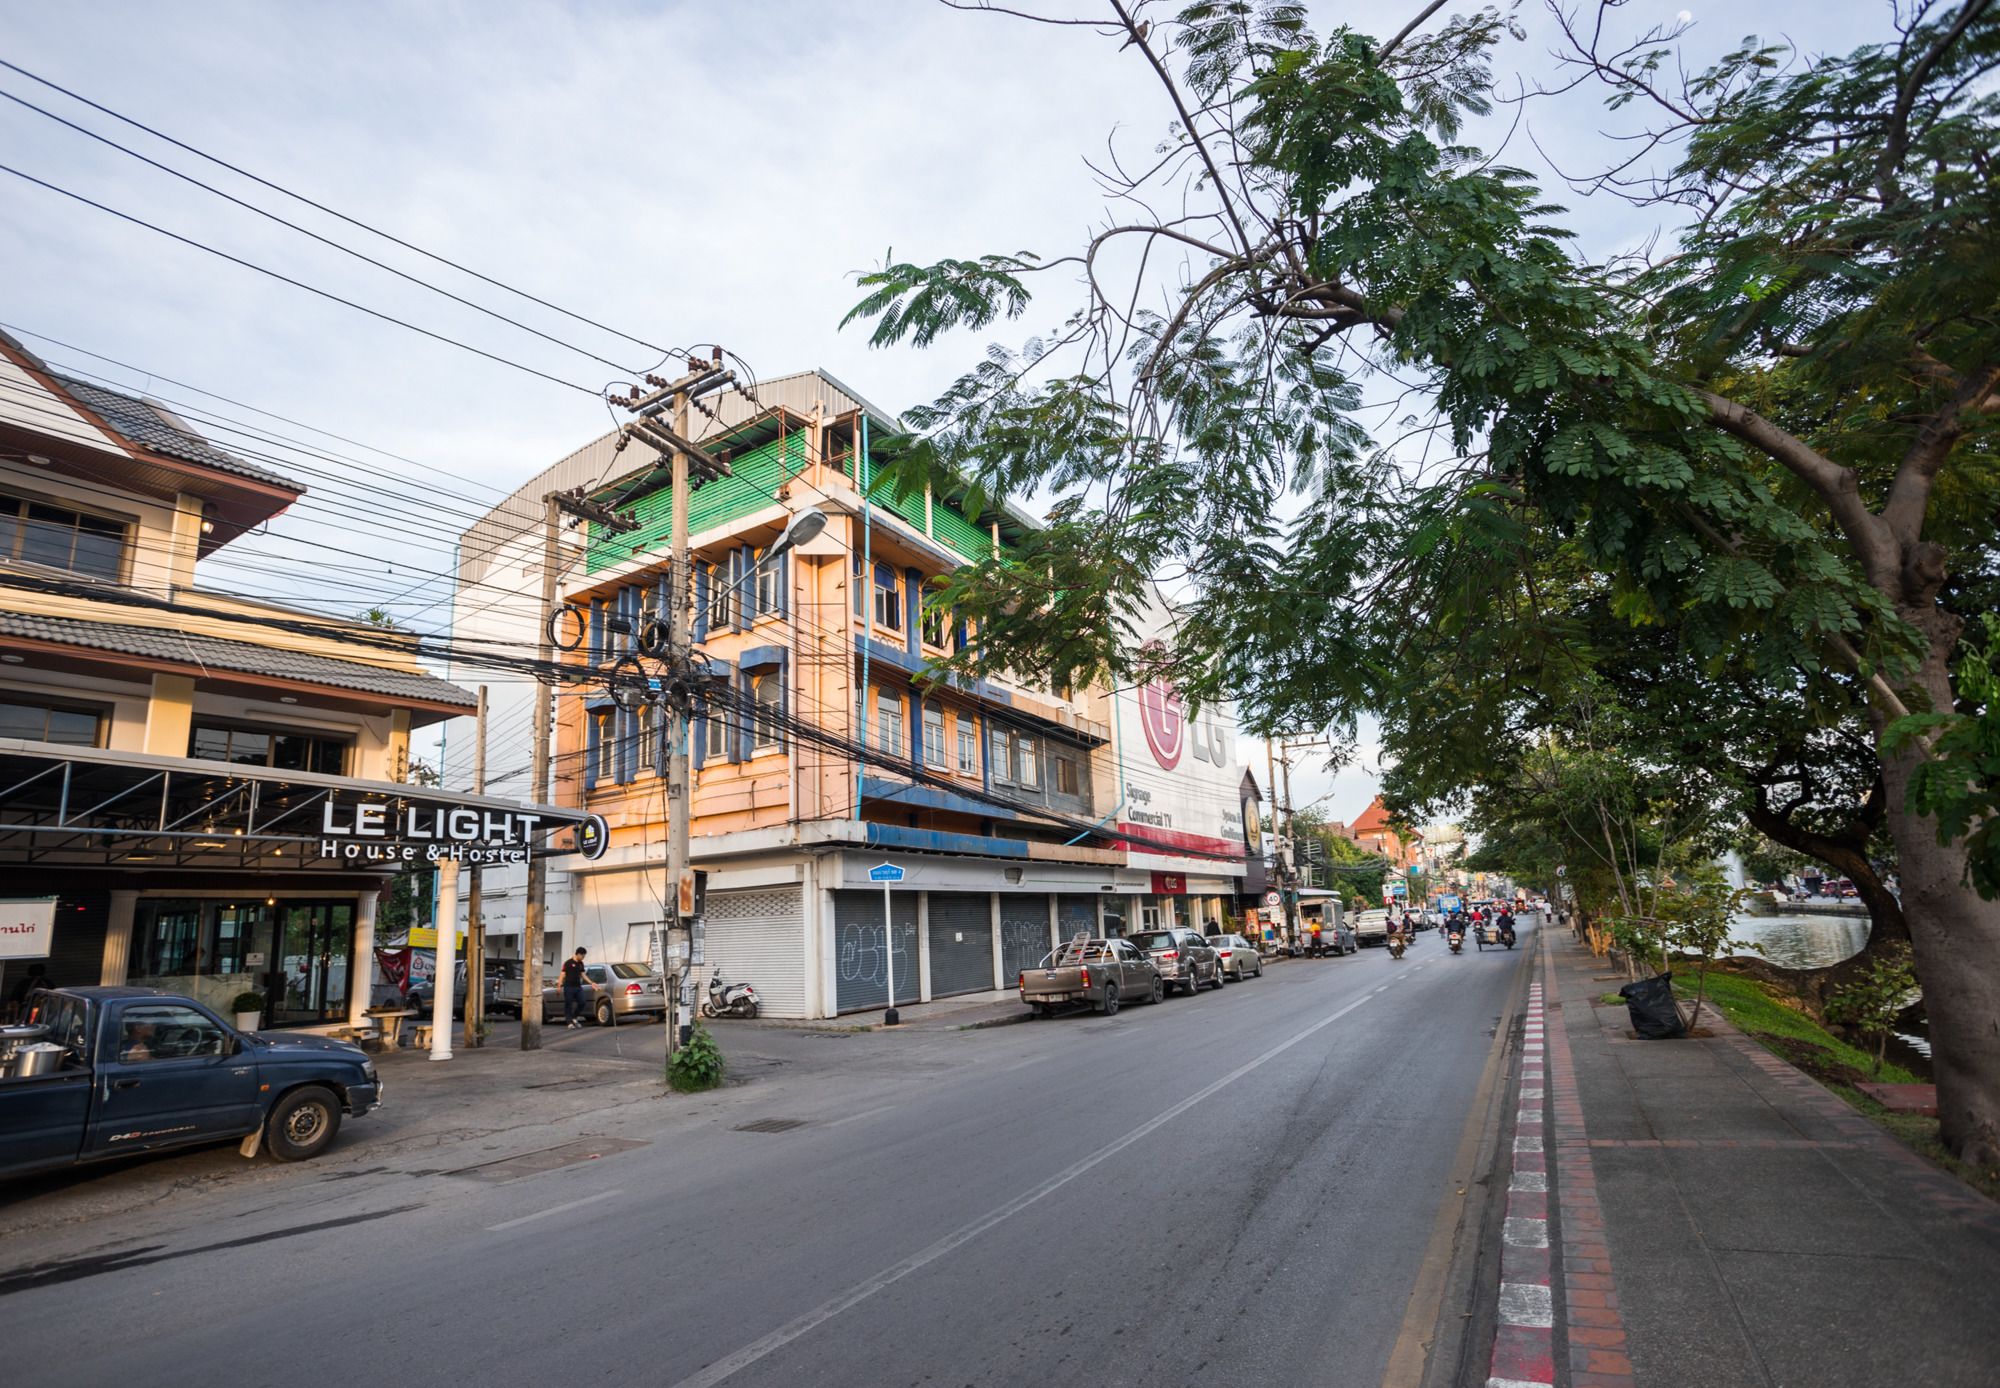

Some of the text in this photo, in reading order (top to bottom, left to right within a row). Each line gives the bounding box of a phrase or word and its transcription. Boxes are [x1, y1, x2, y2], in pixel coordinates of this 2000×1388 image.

[1191, 696, 1226, 768] LG
[1126, 783, 1151, 806] Signage
[323, 801, 540, 843] LE LIGHT
[1128, 805, 1172, 828] Commercial TV
[321, 839, 531, 864] House & Hostel
[1268, 894, 1279, 903] 40
